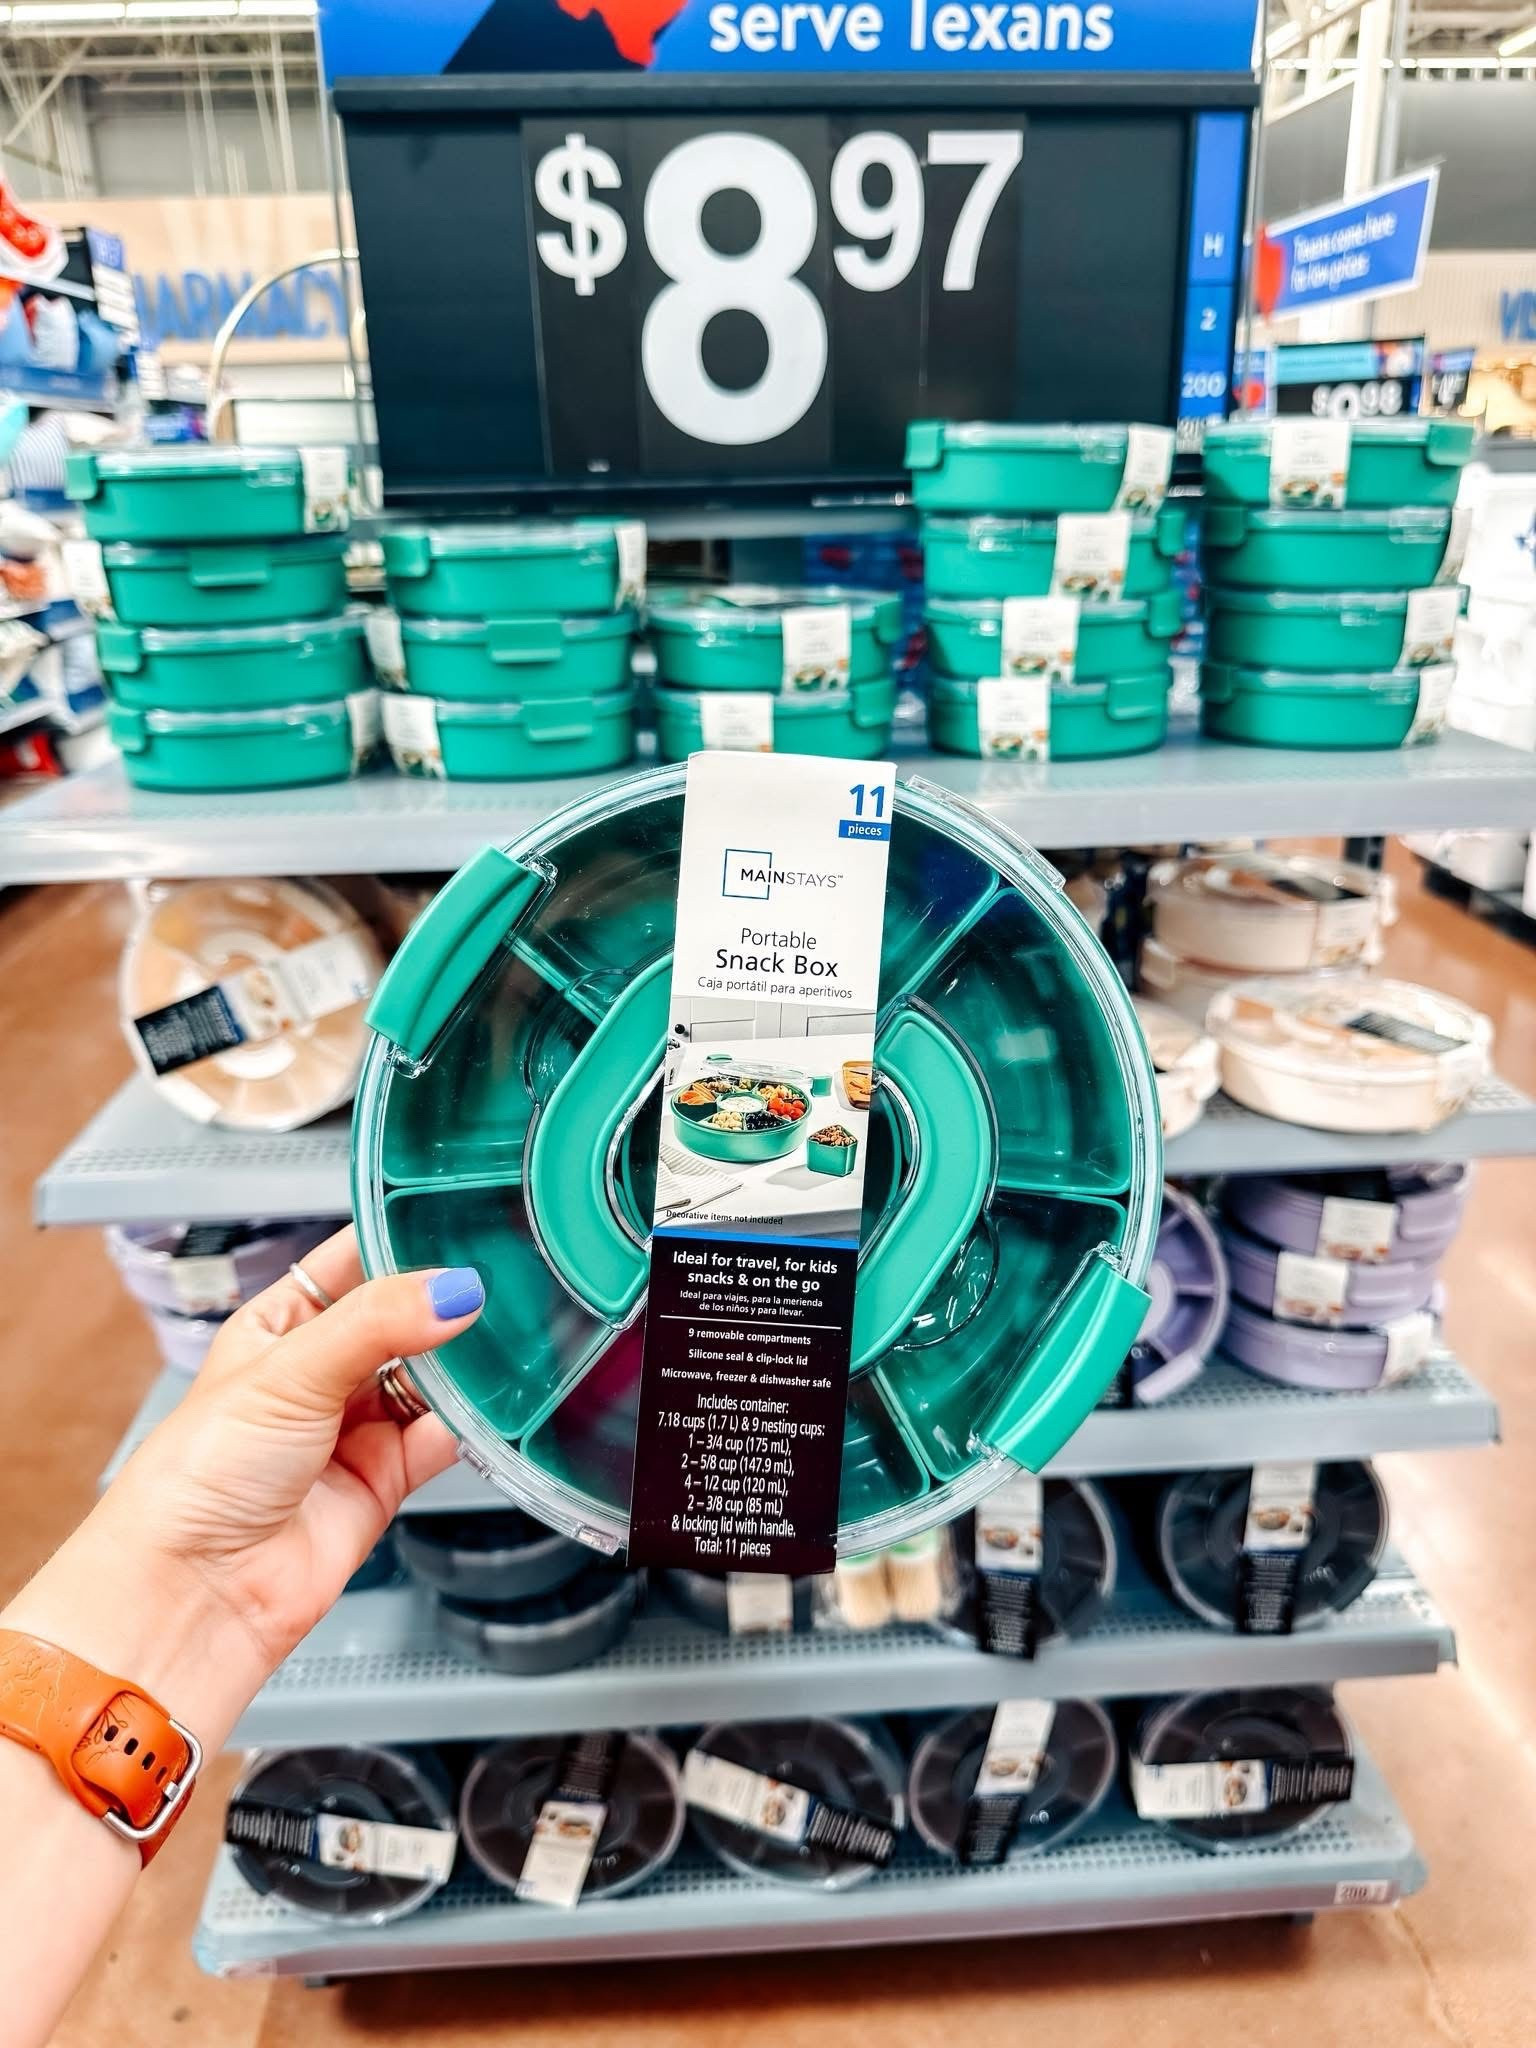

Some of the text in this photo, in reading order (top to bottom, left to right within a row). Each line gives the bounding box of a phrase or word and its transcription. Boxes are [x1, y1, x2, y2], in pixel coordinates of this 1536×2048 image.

[708, 0, 1114, 52] serve Texans
[1200, 306, 1218, 331] 2
[849, 784, 885, 818] 11
[847, 824, 882, 836] pieces
[741, 927, 817, 950] Portable
[716, 949, 838, 977] Snack Box
[697, 976, 853, 999] Caja portátil para aperitivos
[666, 1210, 784, 1225] Decorative items not included
[673, 1251, 838, 1274] Ideal for travel, for kids
[688, 1271, 821, 1292] snacks & on the go
[680, 1290, 823, 1307] Ideal para viajes, para la merienda
[699, 1302, 710, 1311] de
[712, 1303, 724, 1312] los
[726, 1304, 749, 1314] niños
[750, 1306, 756, 1315] y
[757, 1306, 777, 1316] para
[688, 1328, 811, 1345] 9 removable compartments
[688, 1349, 808, 1366] Silicone seal & clip-lock lid
[661, 1368, 832, 1388] Microwave, freezer & dishwasher safe
[697, 1394, 789, 1414] Includes container:
[658, 1412, 825, 1438] 7.18 cups (1.7 L) & 9 nesting cups:
[688, 1433, 693, 1449] 1
[706, 1435, 723, 1450] 3/4
[725, 1438, 743, 1454] cup
[745, 1436, 768, 1454] (175
[681, 1454, 688, 1469] 2
[700, 1455, 717, 1470] 5/8
[719, 1456, 737, 1474] cup
[739, 1456, 772, 1474] (147.9
[684, 1475, 691, 1489] 4
[704, 1475, 720, 1491] 1/2
[722, 1478, 740, 1495] cup
[742, 1477, 765, 1494] (120
[687, 1495, 694, 1511] 2
[706, 1496, 723, 1512] 3/8
[725, 1498, 743, 1516] cup
[745, 1498, 762, 1515] (85
[672, 1515, 680, 1531] &
[682, 1515, 718, 1535] locking
[720, 1517, 733, 1534] lid
[735, 1518, 758, 1535] with
[694, 1537, 771, 1559] Total: 11 pieces
